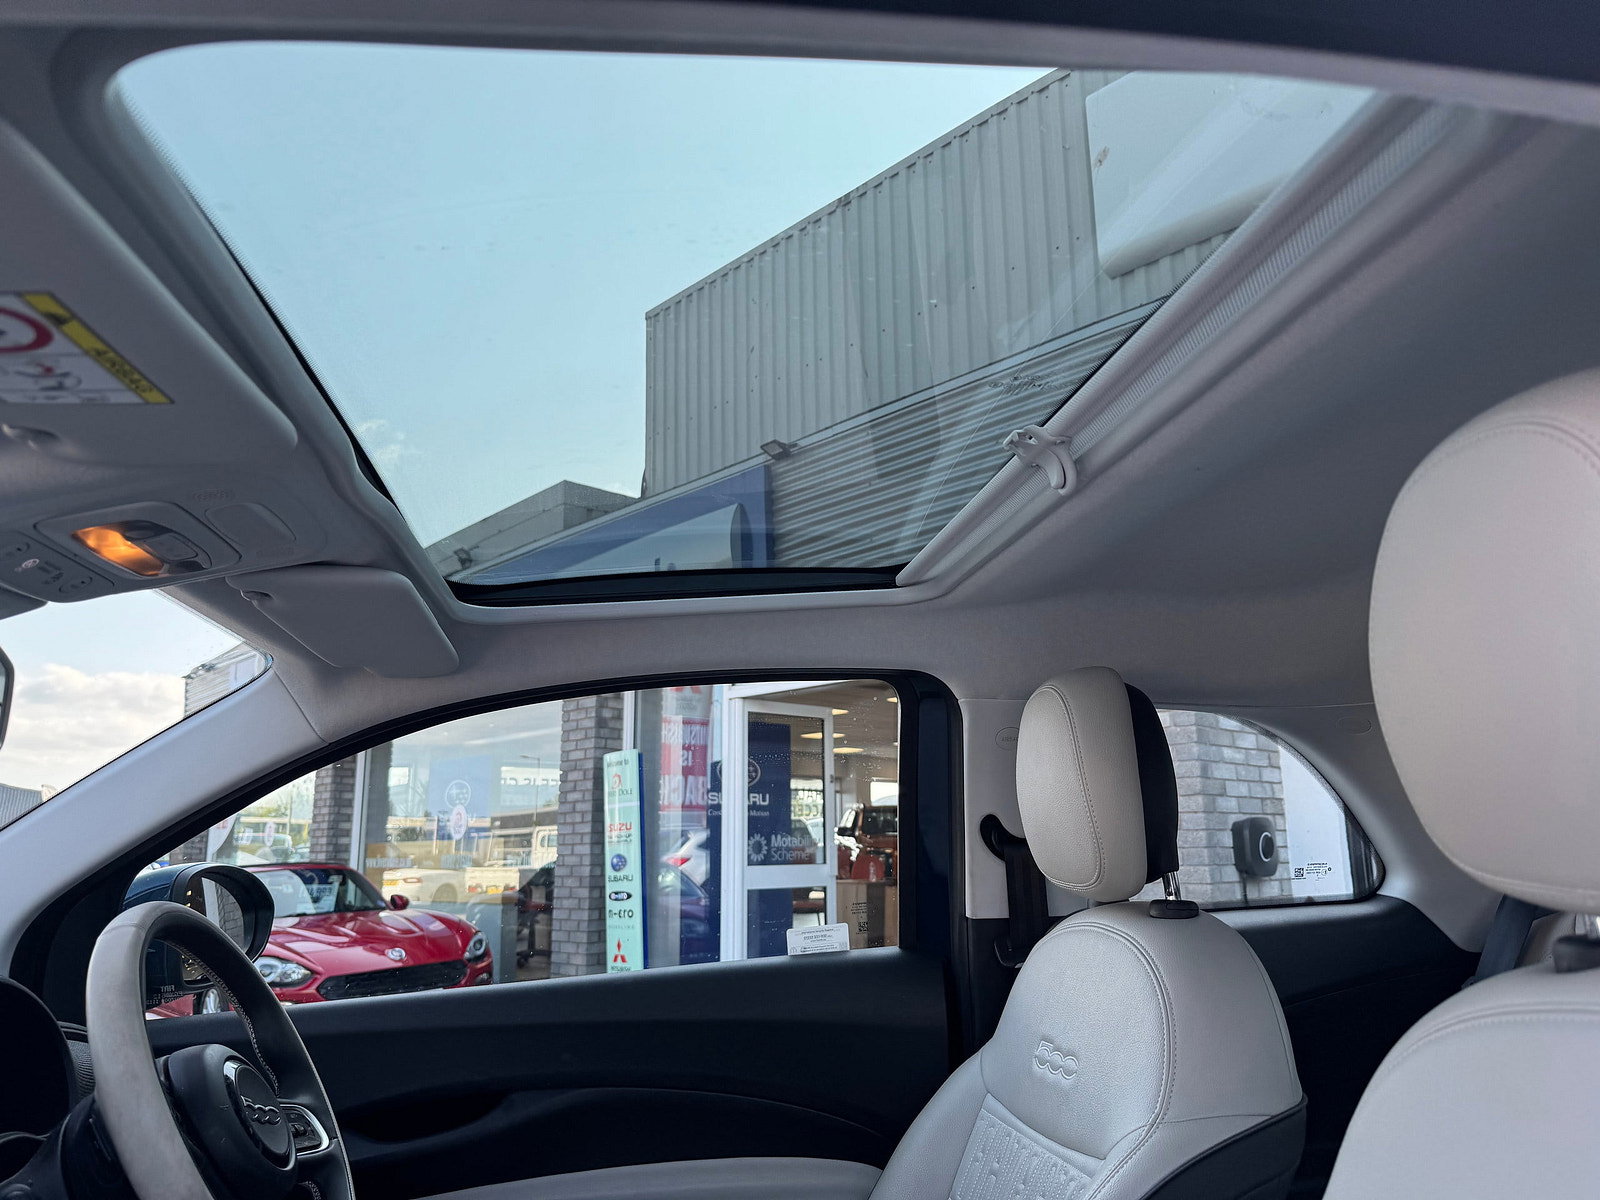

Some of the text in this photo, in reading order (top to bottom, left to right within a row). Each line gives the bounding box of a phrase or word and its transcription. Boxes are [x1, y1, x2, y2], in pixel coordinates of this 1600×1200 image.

[608, 821, 632, 833] SUZU
[771, 847, 809, 861] Scheme
[608, 874, 634, 882] SUBARU
[1034, 1040, 1080, 1080] 500
